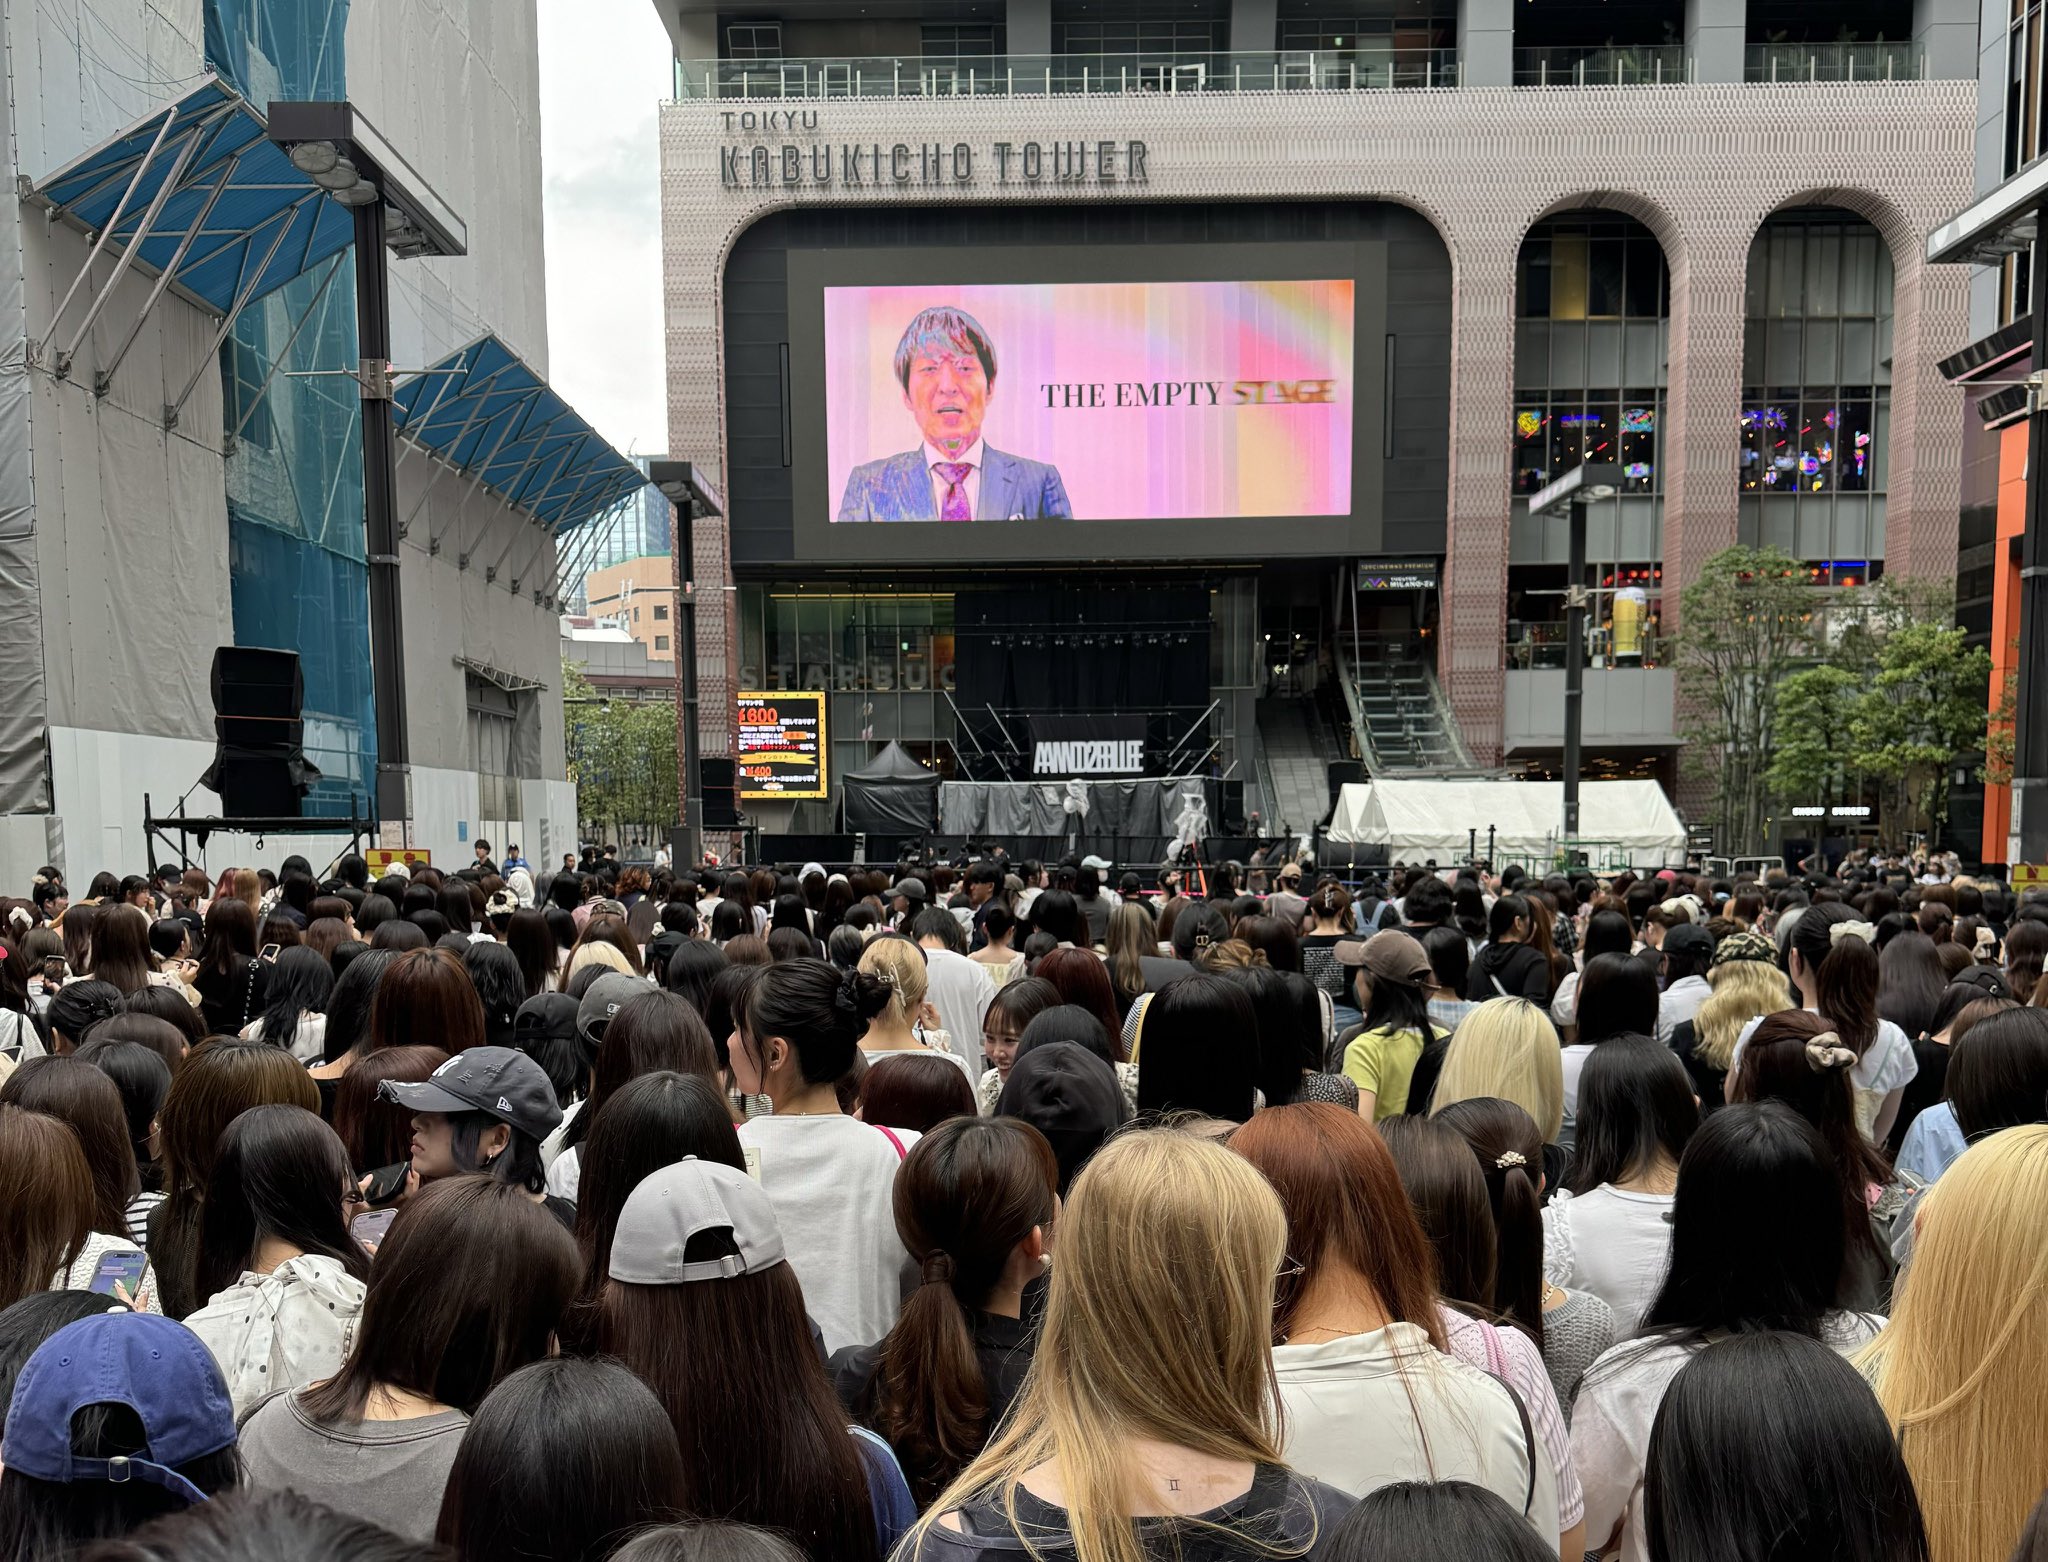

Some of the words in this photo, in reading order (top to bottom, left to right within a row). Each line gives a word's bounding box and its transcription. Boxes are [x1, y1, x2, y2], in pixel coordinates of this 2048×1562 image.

[720, 110, 819, 131] TOKYU
[720, 141, 972, 186] KABUKICHO
[993, 139, 1149, 182] TOWER
[1040, 383, 1106, 408] THE
[1113, 381, 1225, 407] EMPTY
[739, 664, 955, 690] STARBUC
[1792, 807, 1825, 816] SHOGU
